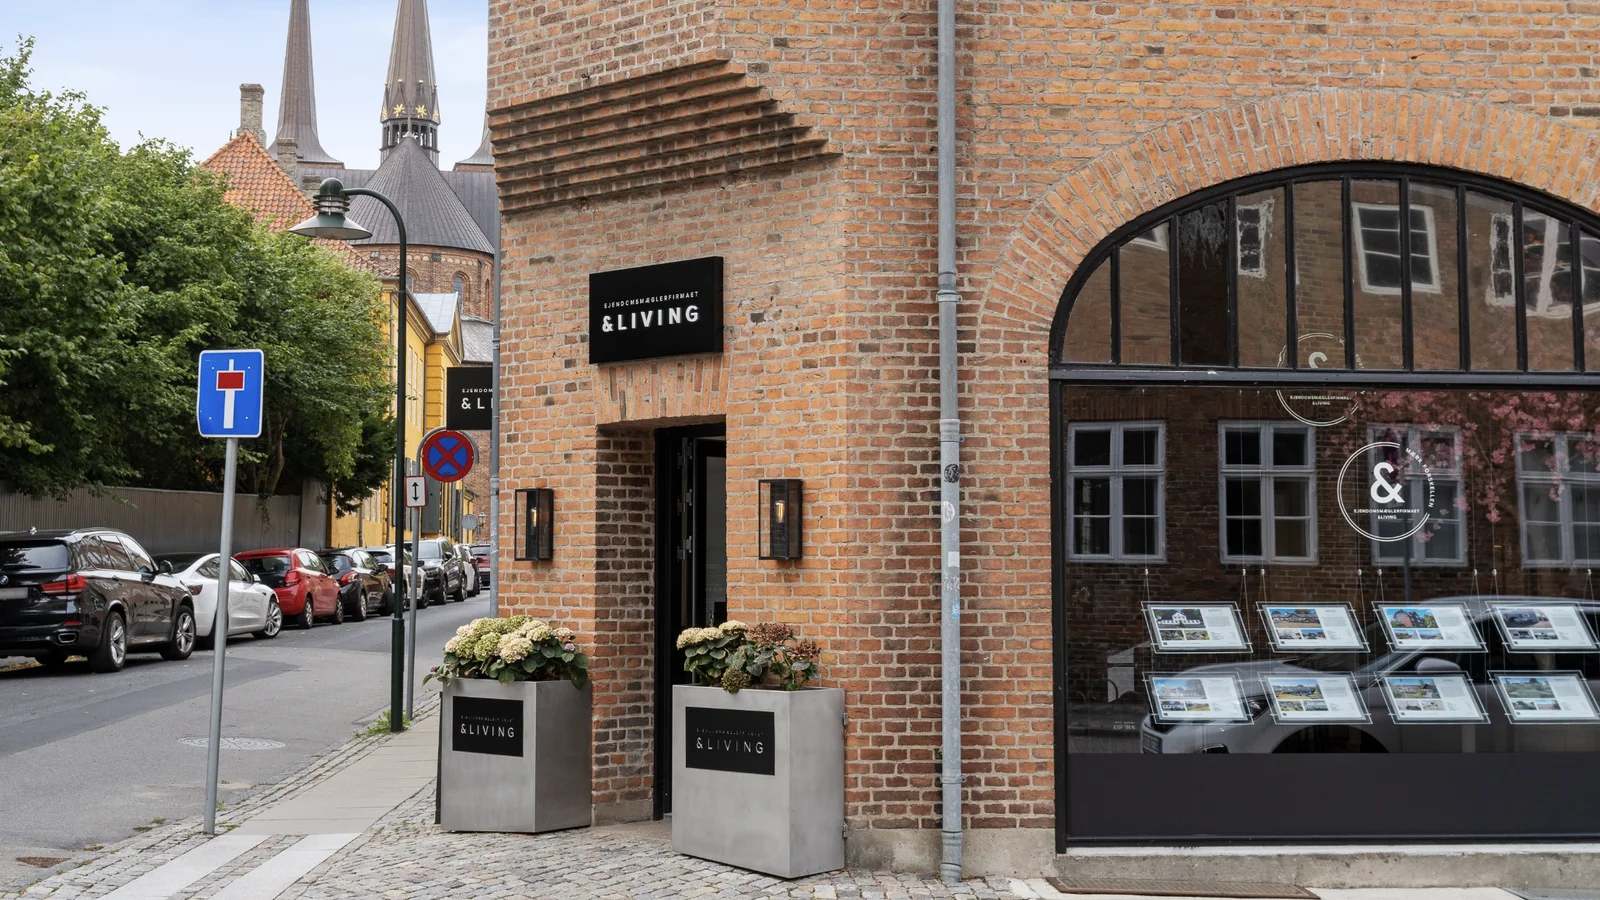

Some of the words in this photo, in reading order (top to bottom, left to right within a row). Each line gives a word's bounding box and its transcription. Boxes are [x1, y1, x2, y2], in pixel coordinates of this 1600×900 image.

[602, 305, 699, 332] &LIVING
[460, 723, 514, 738] &LIVING
[696, 737, 764, 754] &LIVING
